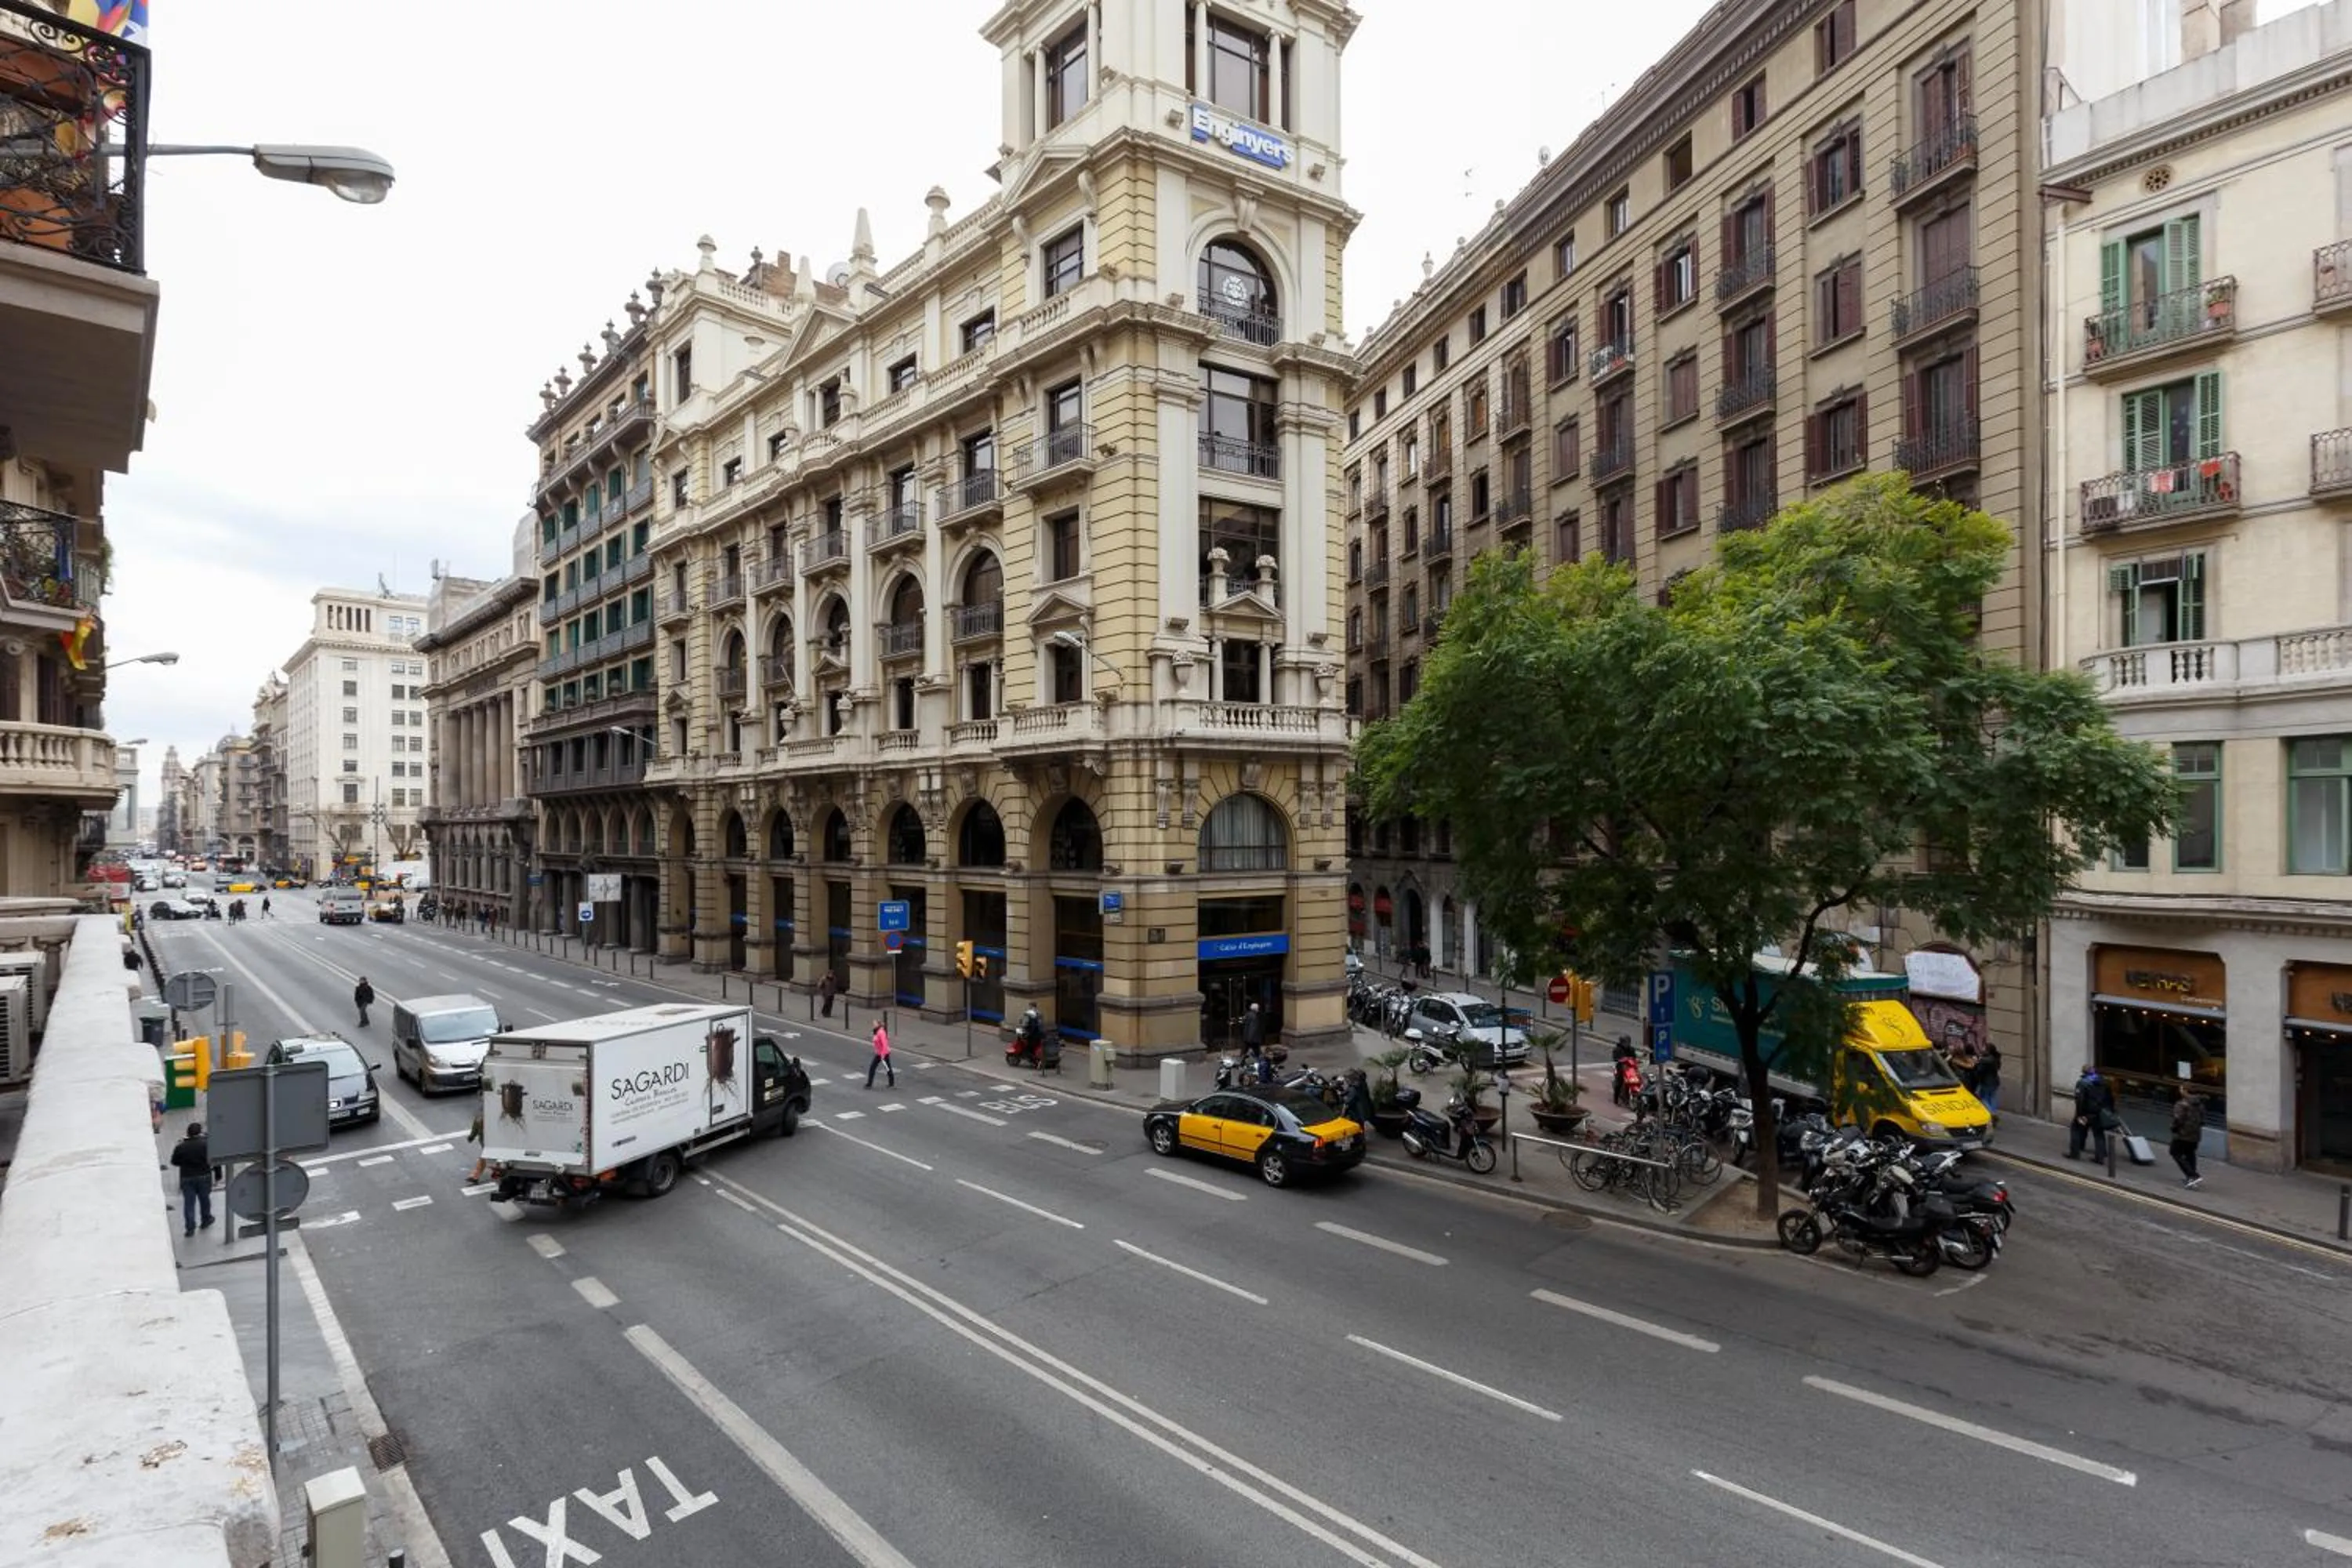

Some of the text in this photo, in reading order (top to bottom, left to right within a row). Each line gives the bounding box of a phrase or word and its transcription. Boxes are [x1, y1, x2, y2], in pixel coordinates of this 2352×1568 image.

[1192, 106, 1294, 162] Enginyers
[1654, 975, 1670, 1004] P
[1658, 1031, 1667, 1044] P
[611, 1062, 689, 1100] SAGARDI
[532, 1099, 574, 1112] SAGARDI
[978, 1094, 1058, 1114] BUS
[480, 1456, 720, 1568] TAXI
